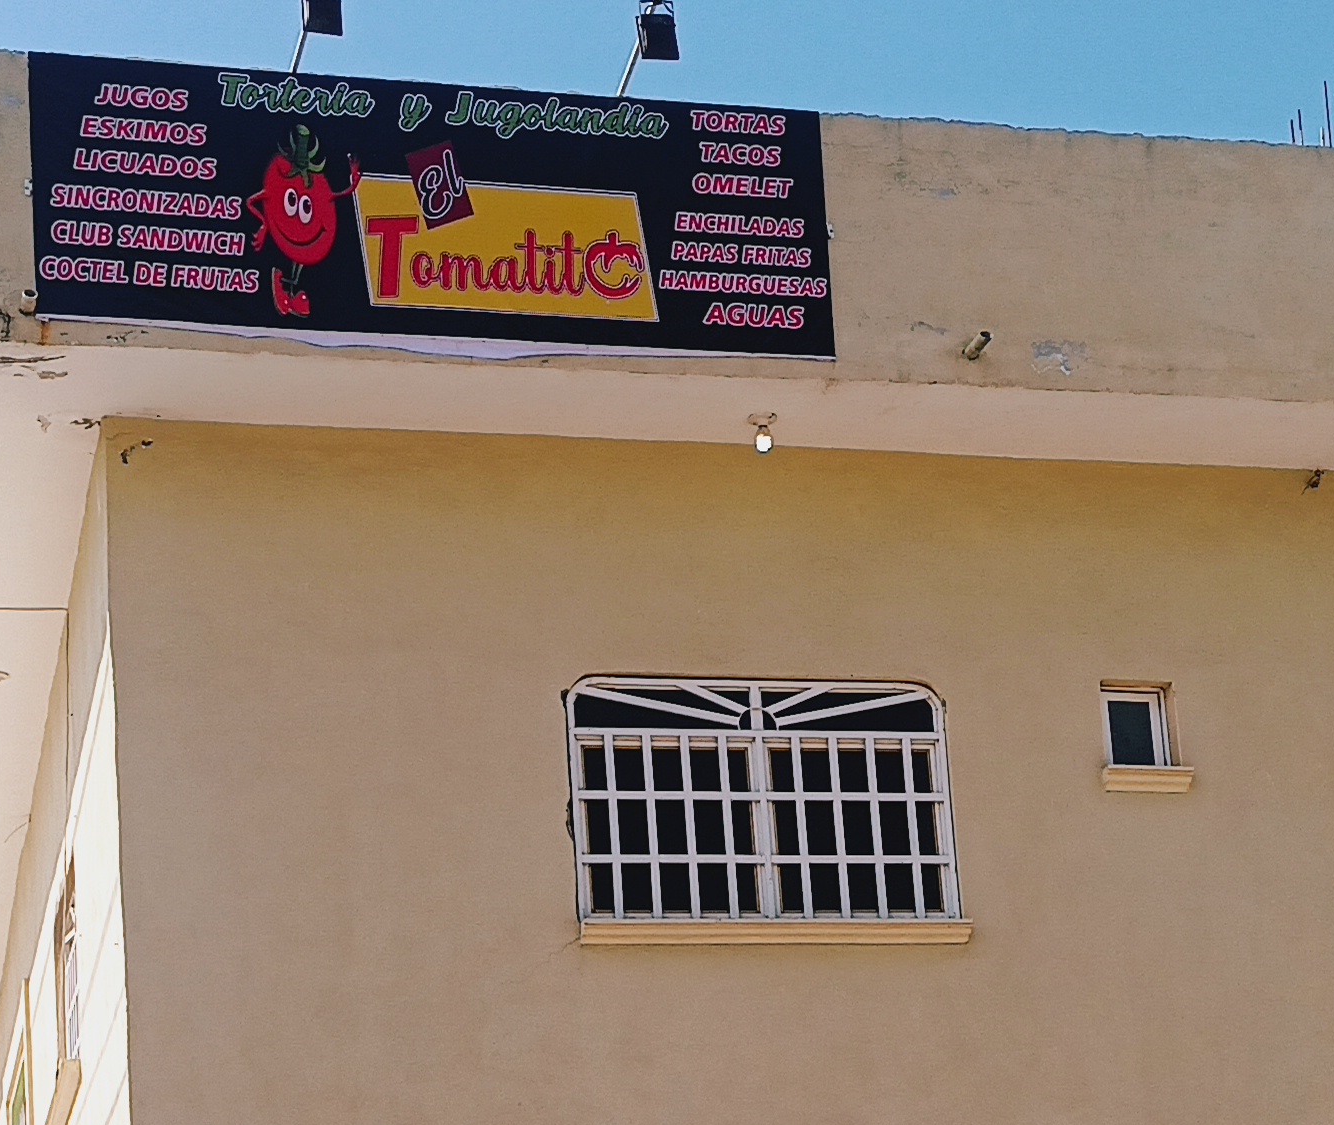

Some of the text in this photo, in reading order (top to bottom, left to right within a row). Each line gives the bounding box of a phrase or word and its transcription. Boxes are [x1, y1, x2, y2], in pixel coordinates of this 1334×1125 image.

[94, 83, 189, 111] JUGOS
[218, 72, 668, 139] Torteria y Jugolandia
[80, 116, 207, 145] ESKIMOS
[690, 110, 786, 135] TORTAS
[73, 148, 217, 179] LICUADOS
[699, 142, 781, 167] TACOS
[419, 150, 463, 219] El
[692, 173, 793, 198] OMELET
[50, 184, 241, 220] SINCRONIZADAS
[51, 220, 245, 256] CLUB SANDWICH
[675, 212, 804, 237] ENCHILADAS
[671, 242, 811, 267] PAPAS FRITAS
[40, 256, 259, 292] COCTEL DE FRUTAS
[659, 270, 827, 297] HAMBURGUESAS
[703, 302, 804, 329] AGUAS
